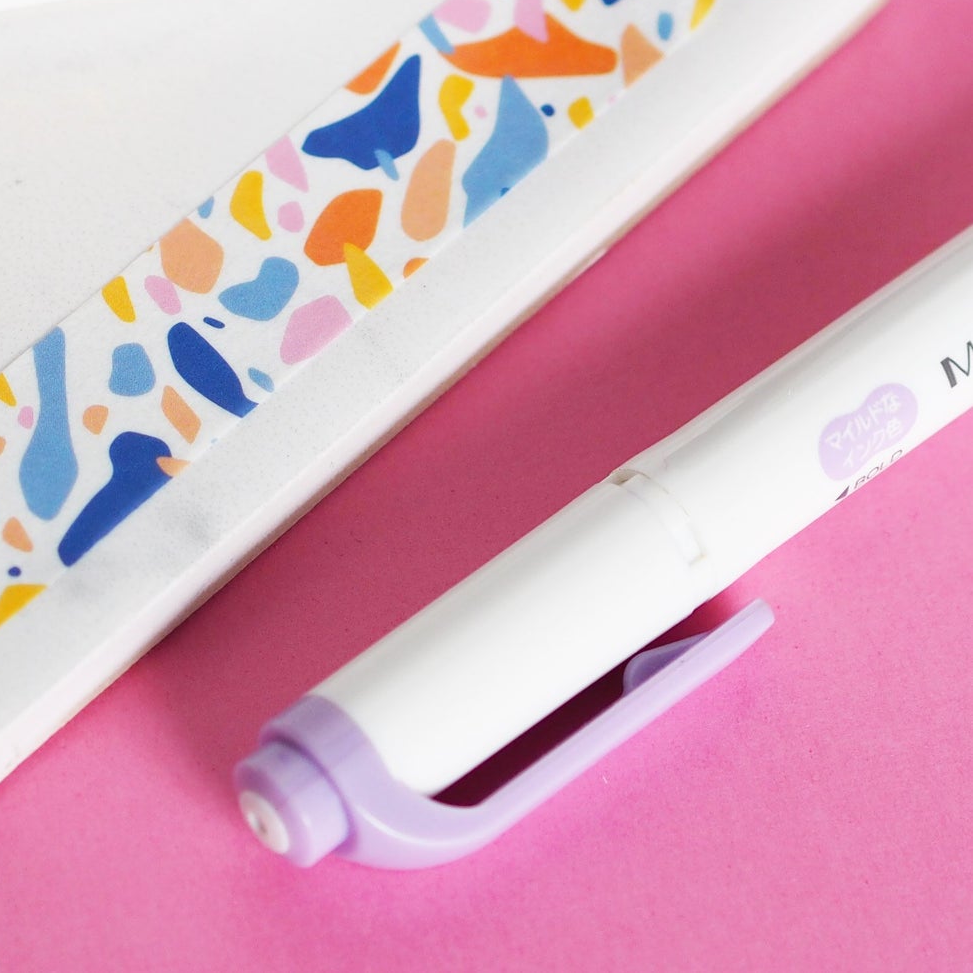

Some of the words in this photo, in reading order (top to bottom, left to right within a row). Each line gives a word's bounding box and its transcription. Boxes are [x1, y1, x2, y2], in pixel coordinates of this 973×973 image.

[825, 391, 902, 450] マイルドな
[842, 418, 903, 469] インク色
